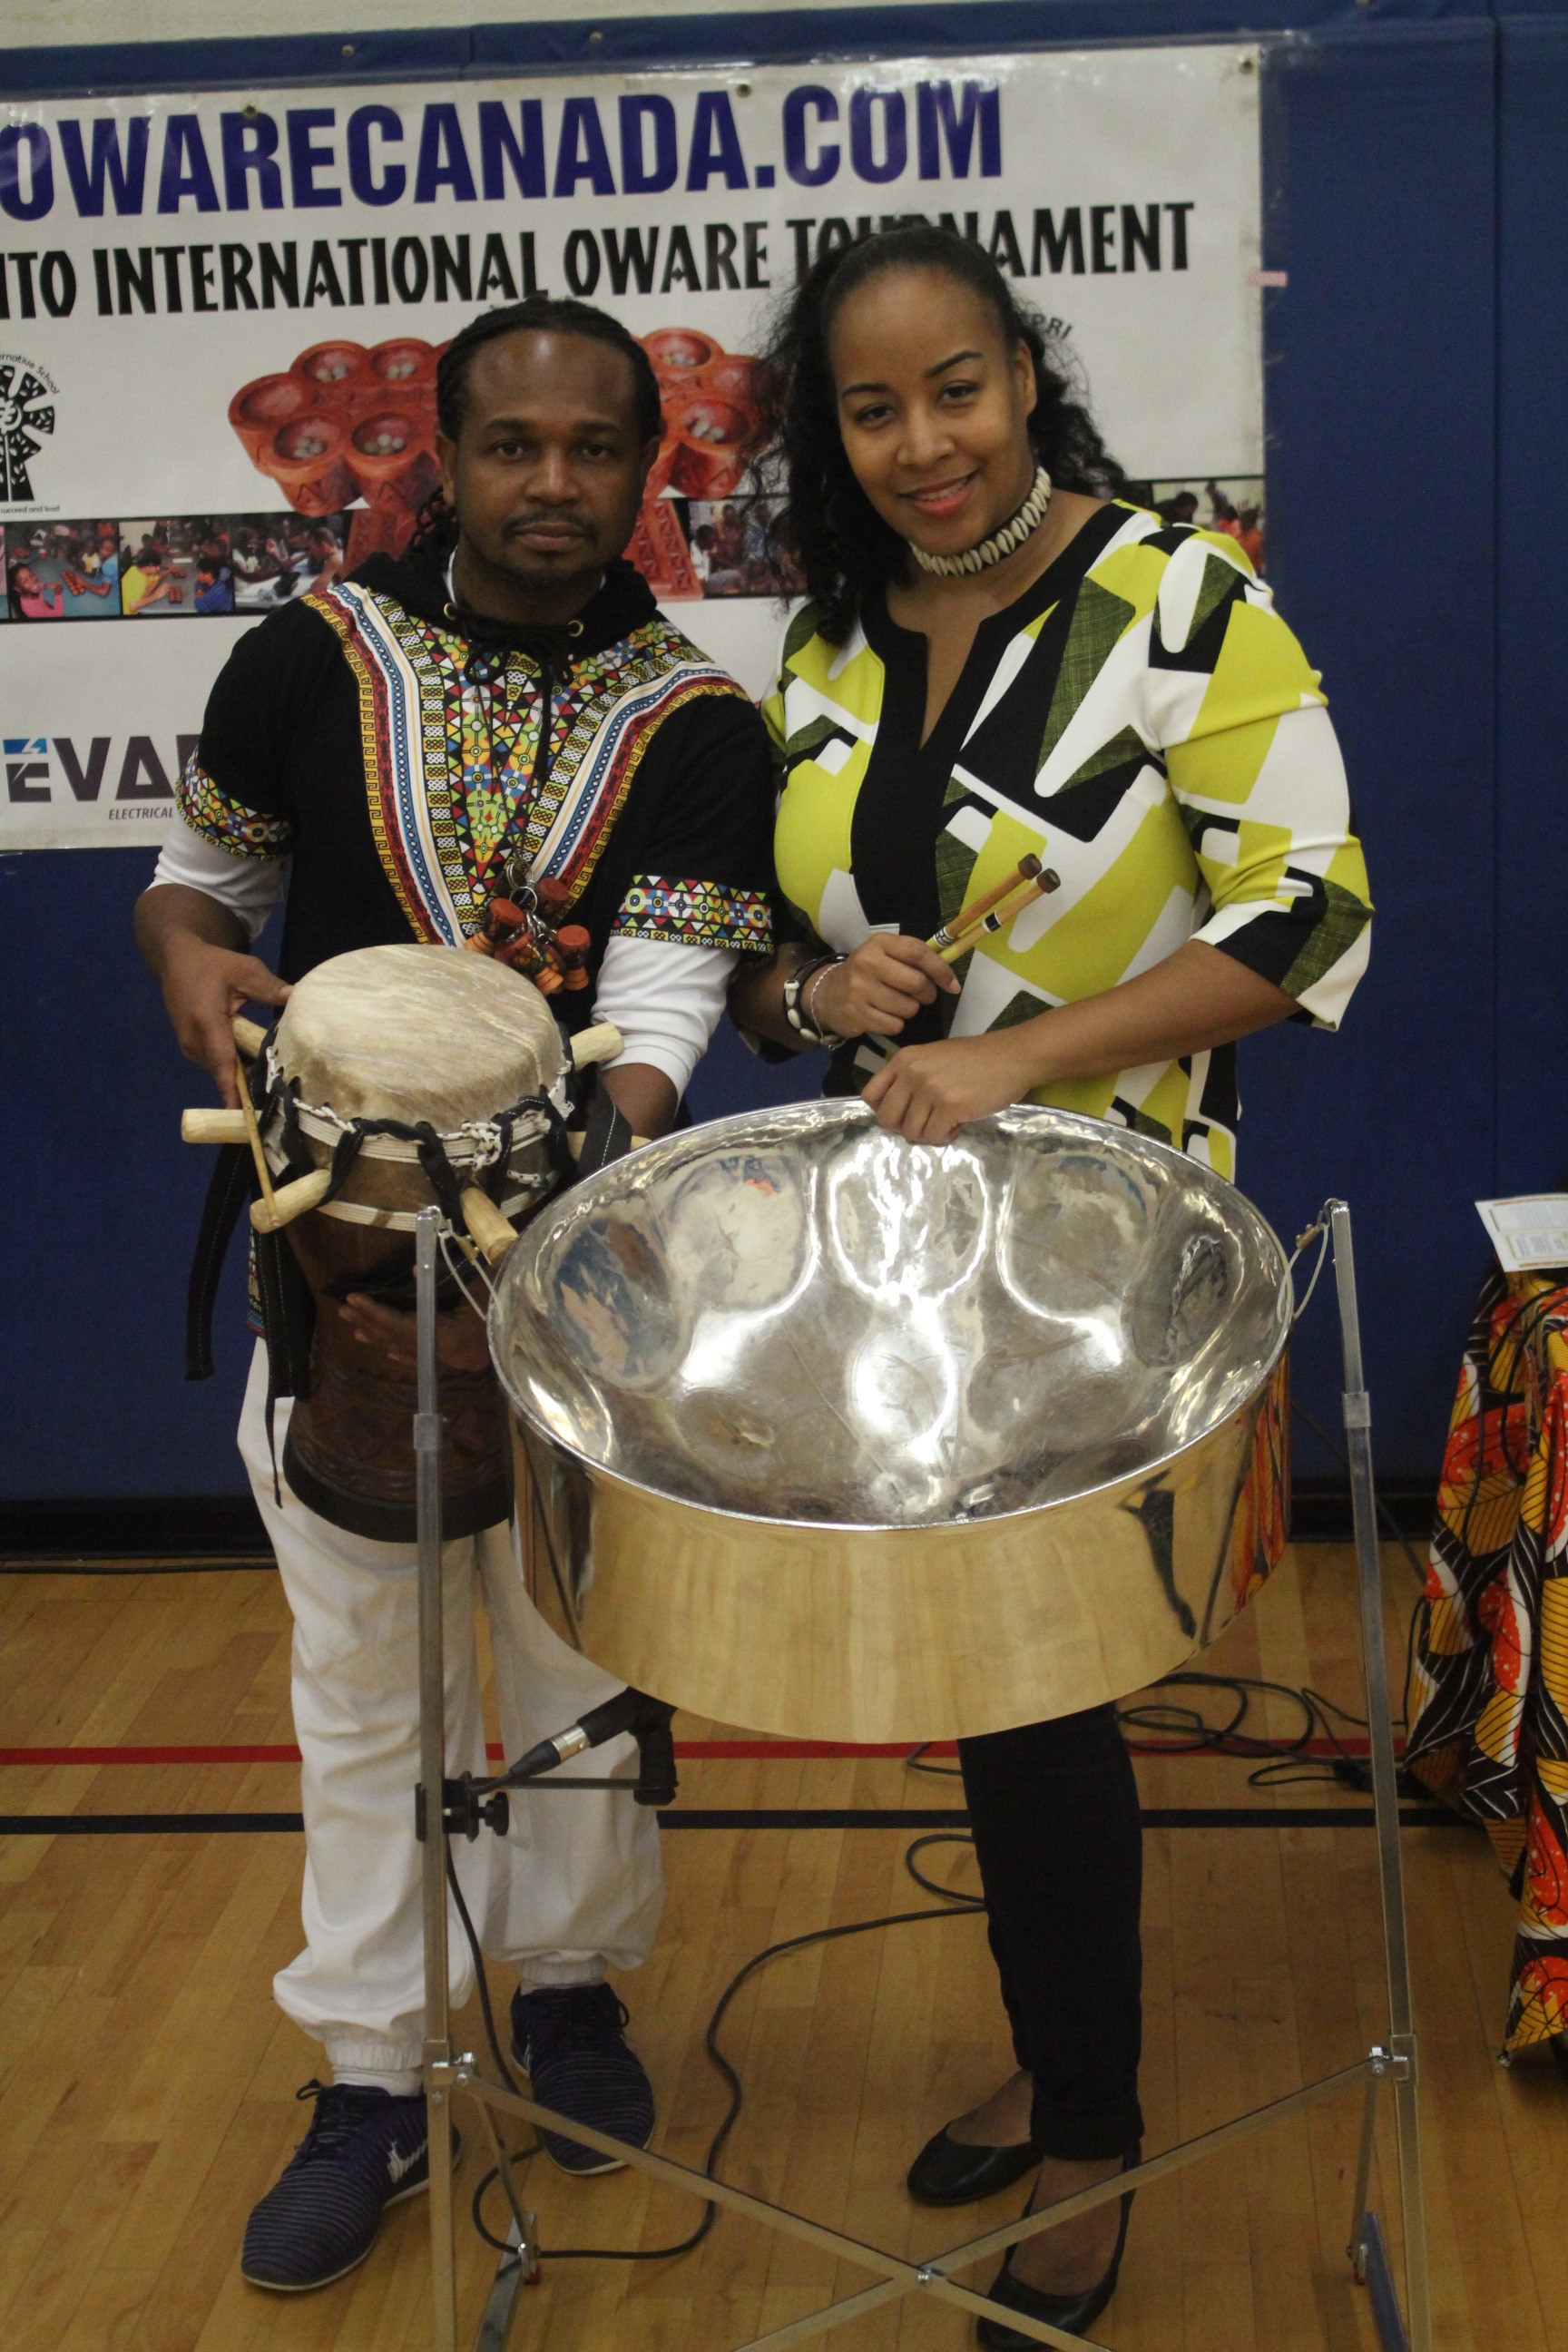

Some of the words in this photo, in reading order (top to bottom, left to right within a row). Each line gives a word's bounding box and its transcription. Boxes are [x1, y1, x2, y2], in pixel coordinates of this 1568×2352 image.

[0, 79, 1003, 221] OWARECANADA.COM
[93, 231, 549, 317] INTERNATIONAL
[563, 220, 770, 297] OWARE
[28, 505, 43, 514] and
[108, 807, 174, 820] ELECTRICAL
